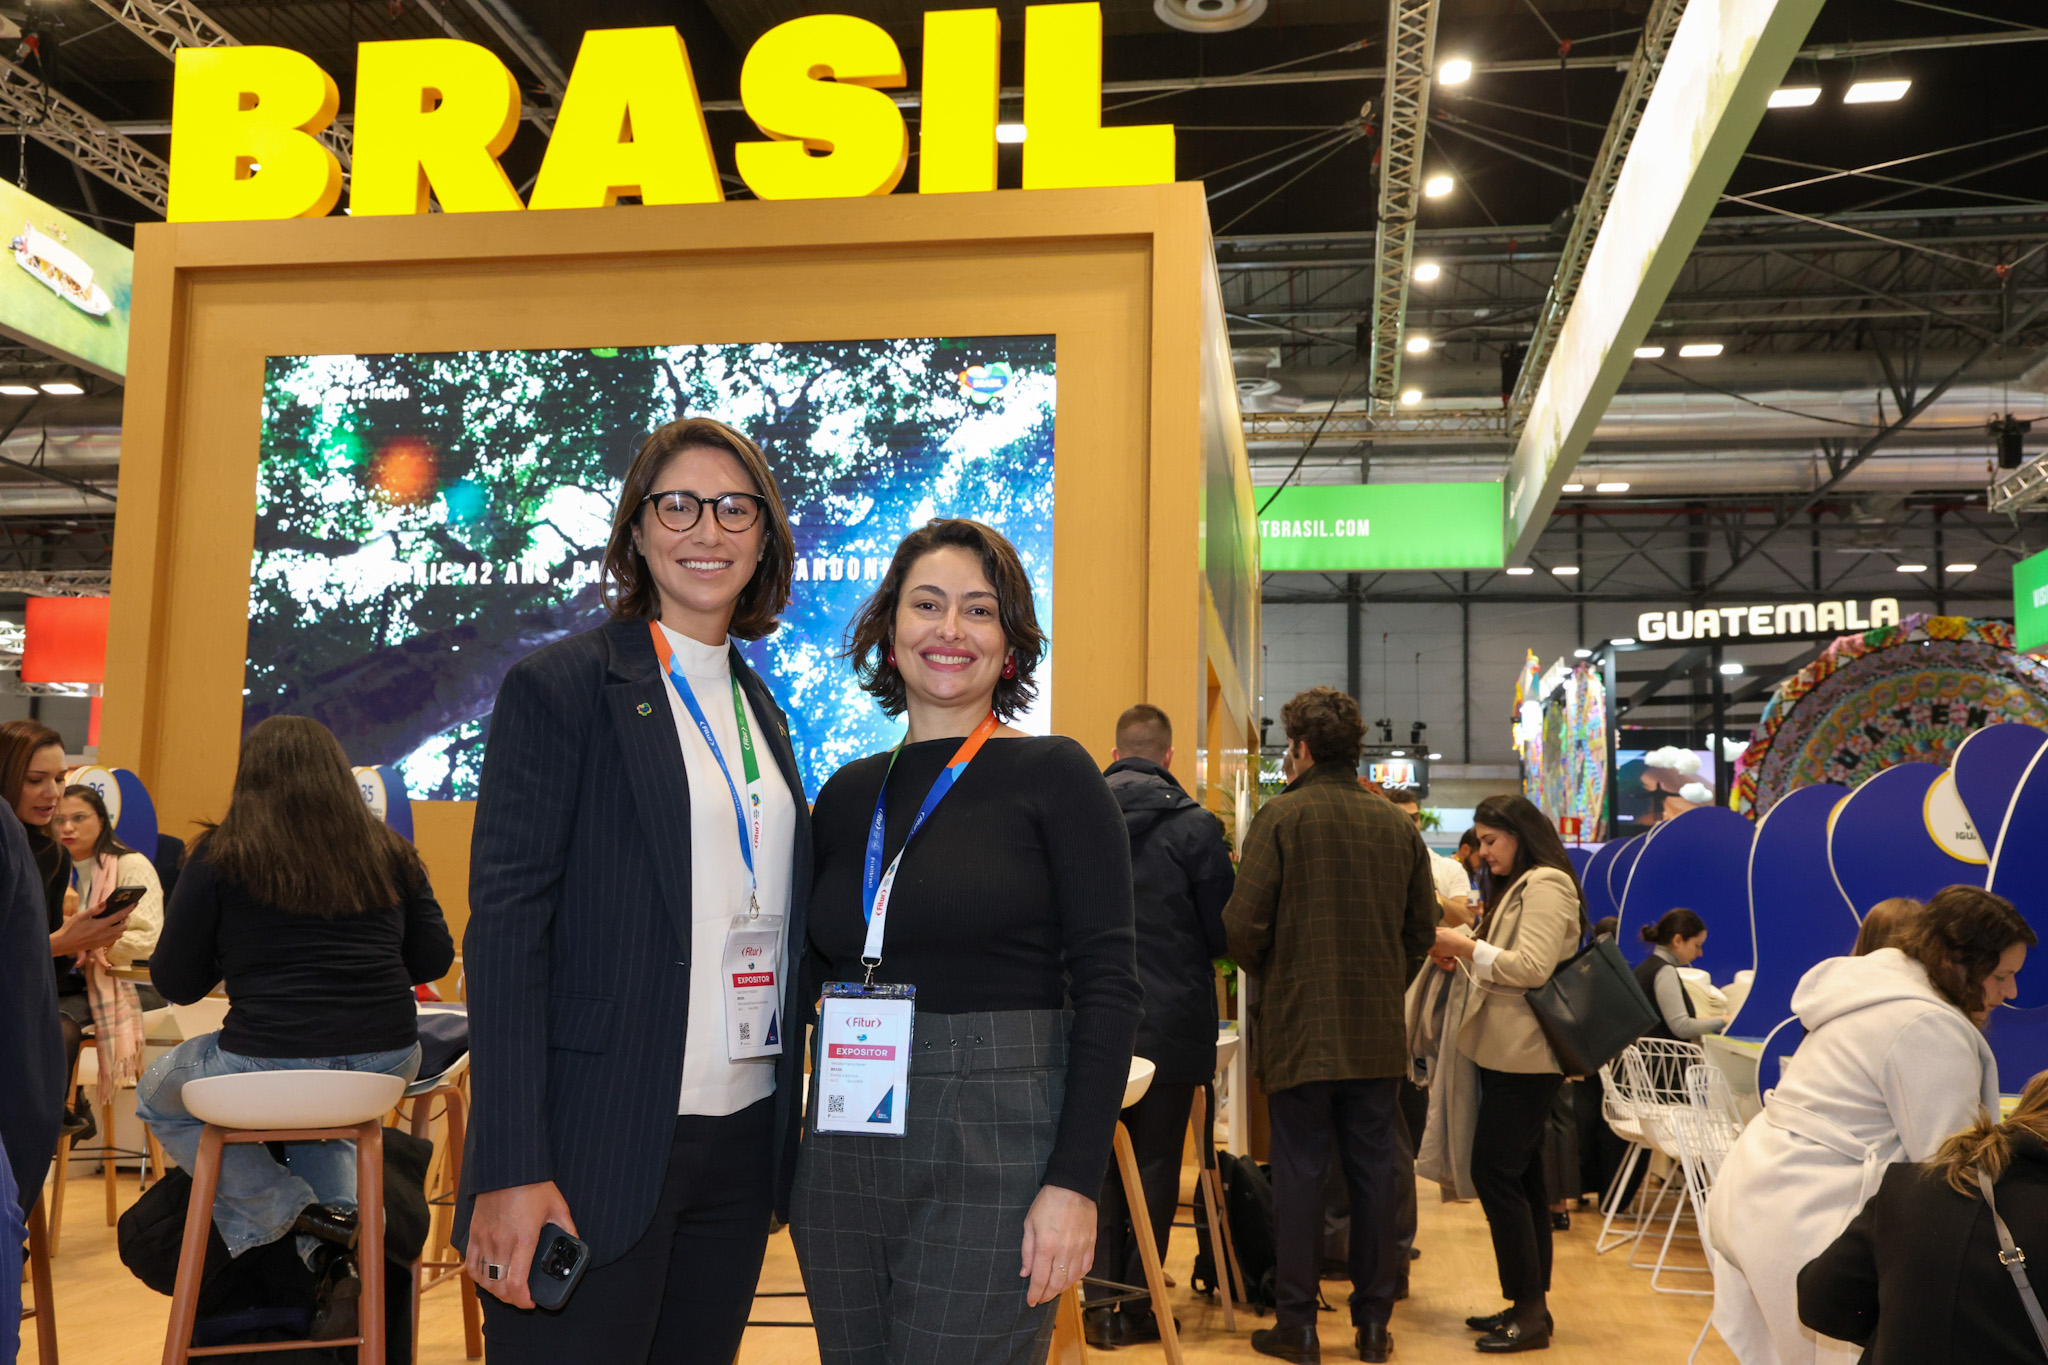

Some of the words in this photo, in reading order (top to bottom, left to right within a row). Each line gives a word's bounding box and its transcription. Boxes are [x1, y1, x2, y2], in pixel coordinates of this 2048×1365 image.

[167, 2, 1176, 222] BRASIL
[1638, 597, 1899, 642] GUATEMALA
[737, 976, 771, 985] EXPOSITOR
[836, 1047, 888, 1057] EXPOSITOR
